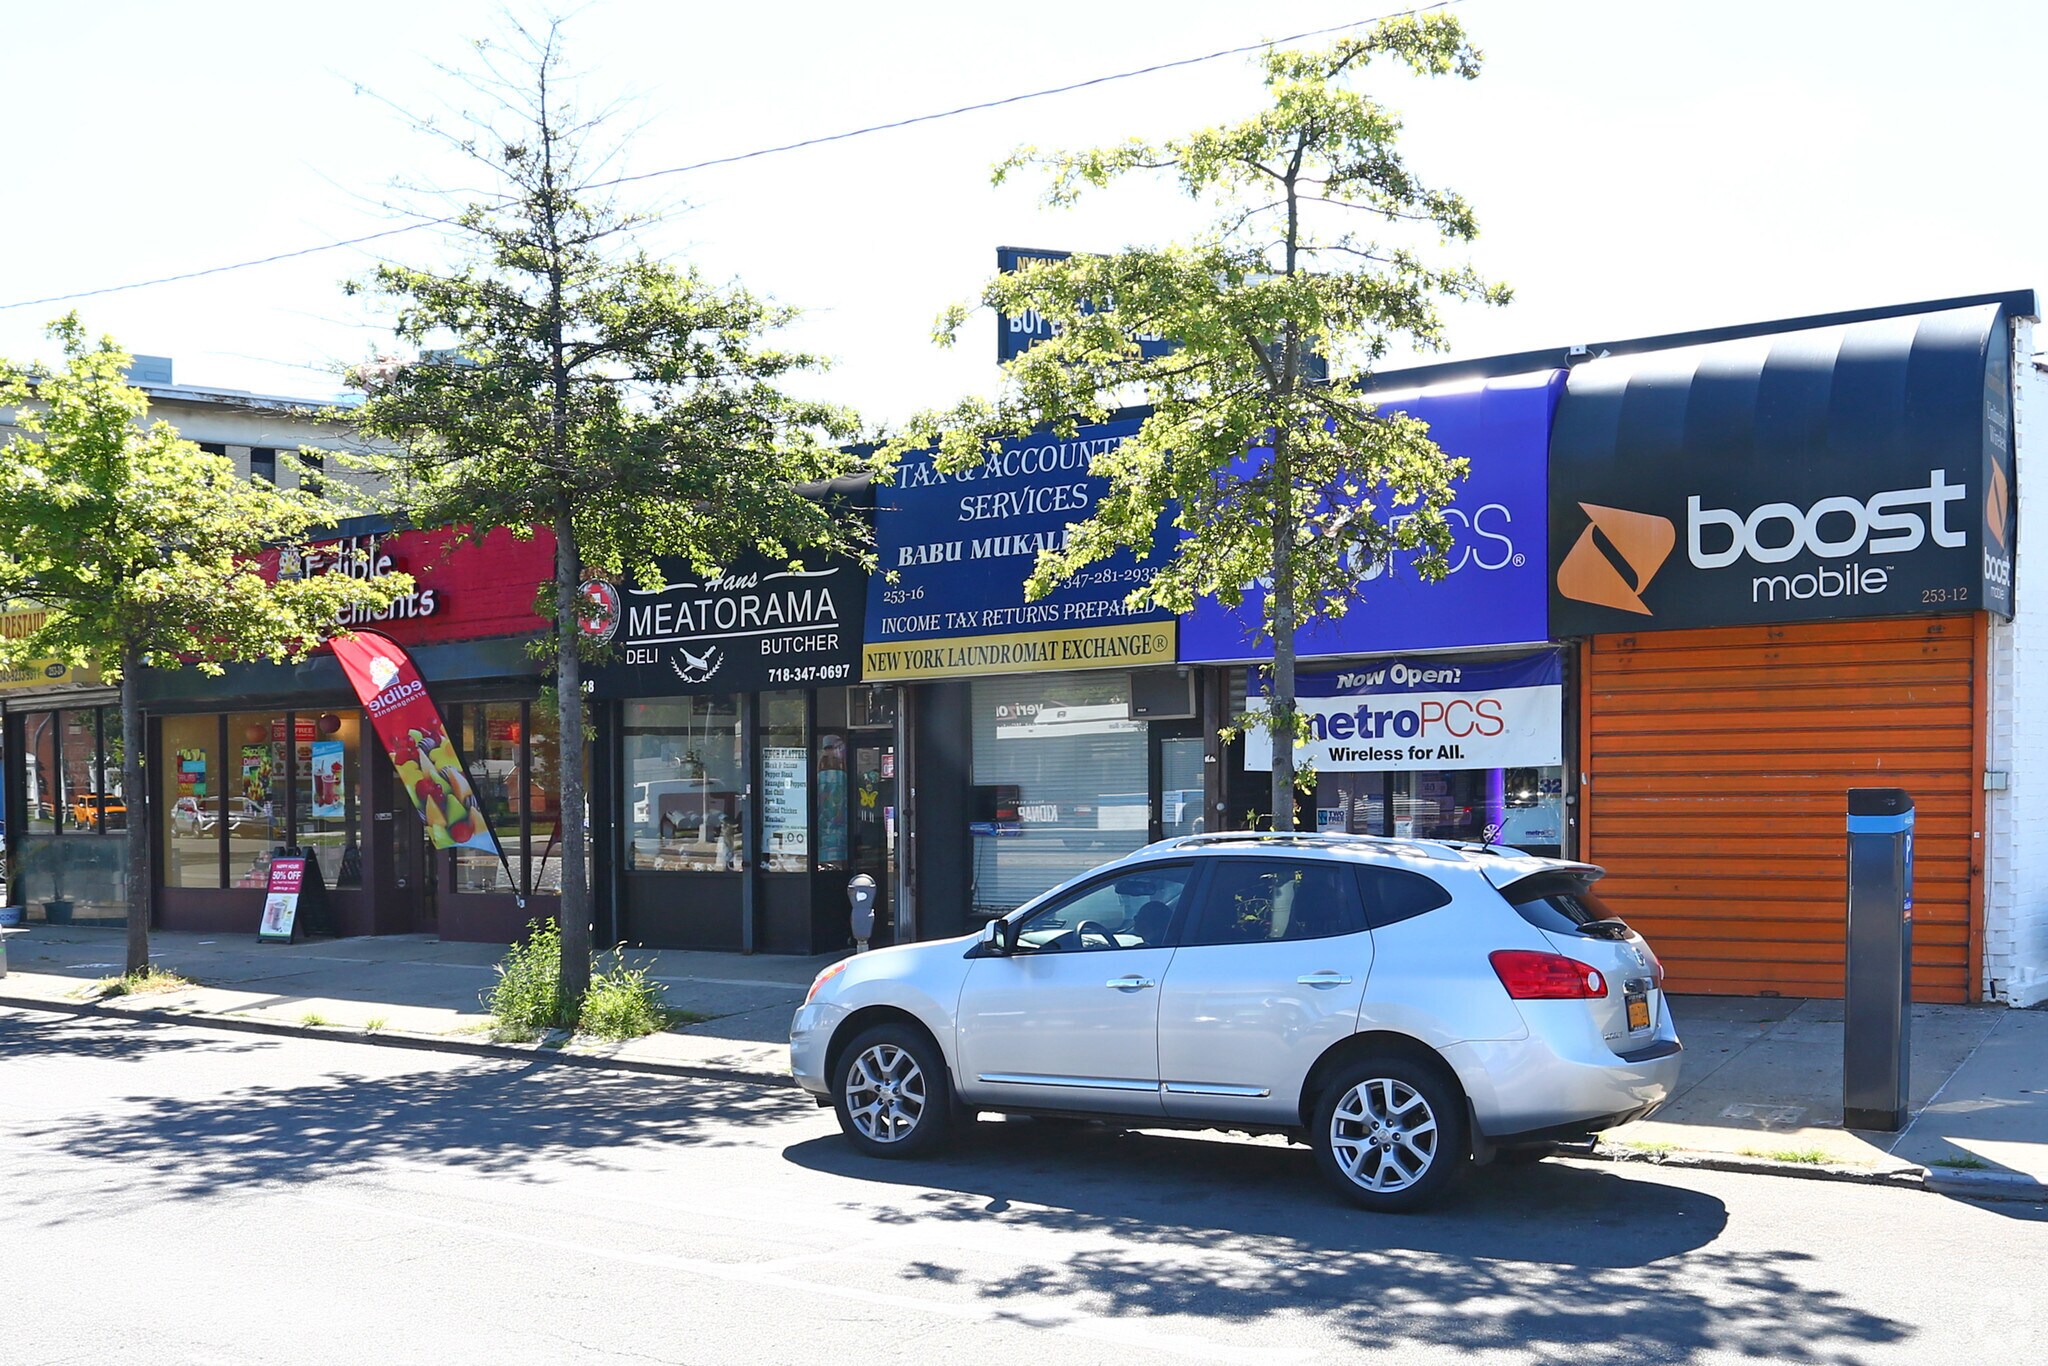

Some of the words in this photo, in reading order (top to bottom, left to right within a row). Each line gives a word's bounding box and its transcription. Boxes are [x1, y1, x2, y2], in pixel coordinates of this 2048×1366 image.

[958, 483, 1089, 522] SERVICES
[1687, 468, 1966, 569] boost
[898, 541, 963, 567] BABU
[1984, 547, 2010, 586] boost
[703, 567, 758, 593] Hans
[1063, 566, 1159, 590] 347-281-2933
[883, 585, 925, 605] 253-16
[1921, 587, 1968, 603] 253-12
[628, 588, 838, 637] MEATORAMA
[881, 613, 941, 634] INCOME
[945, 610, 979, 630] TAX
[981, 604, 1059, 628] RETURNS
[626, 648, 659, 665] DELI
[761, 633, 839, 655] BUTCHER
[866, 651, 901, 673] NEW
[904, 648, 945, 669] YORK
[948, 640, 1059, 668] LAUNDROMAT
[768, 664, 850, 683] 718-347-0697
[1336, 669, 1386, 689] Now
[1389, 663, 1462, 688] Open!
[1328, 746, 1403, 762] Wireless
[1407, 745, 1433, 760] for
[1437, 744, 1465, 760] All.
[271, 871, 286, 880] 50%
[287, 871, 301, 880] OFF
